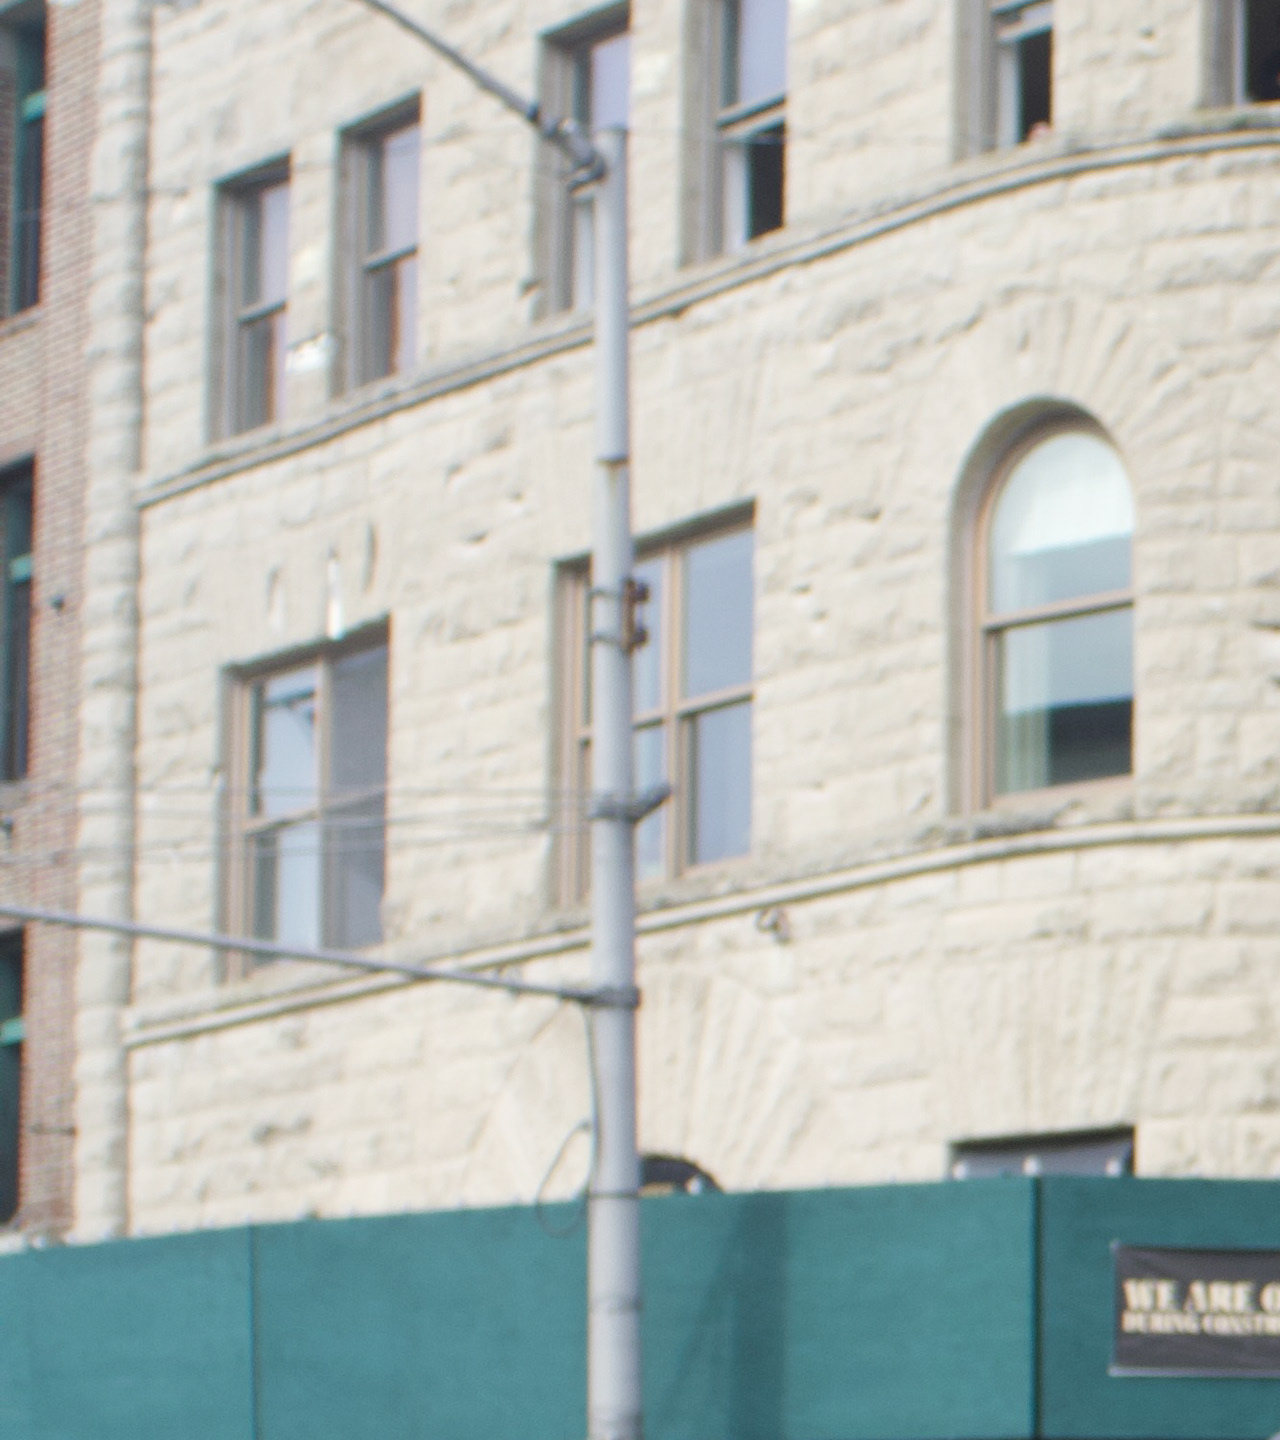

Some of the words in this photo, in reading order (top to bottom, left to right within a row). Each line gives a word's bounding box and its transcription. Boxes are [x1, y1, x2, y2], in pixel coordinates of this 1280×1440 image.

[1122, 1278, 1176, 1311] WE
[1183, 1280, 1254, 1313] ARE
[1122, 1311, 1200, 1334] DURING
